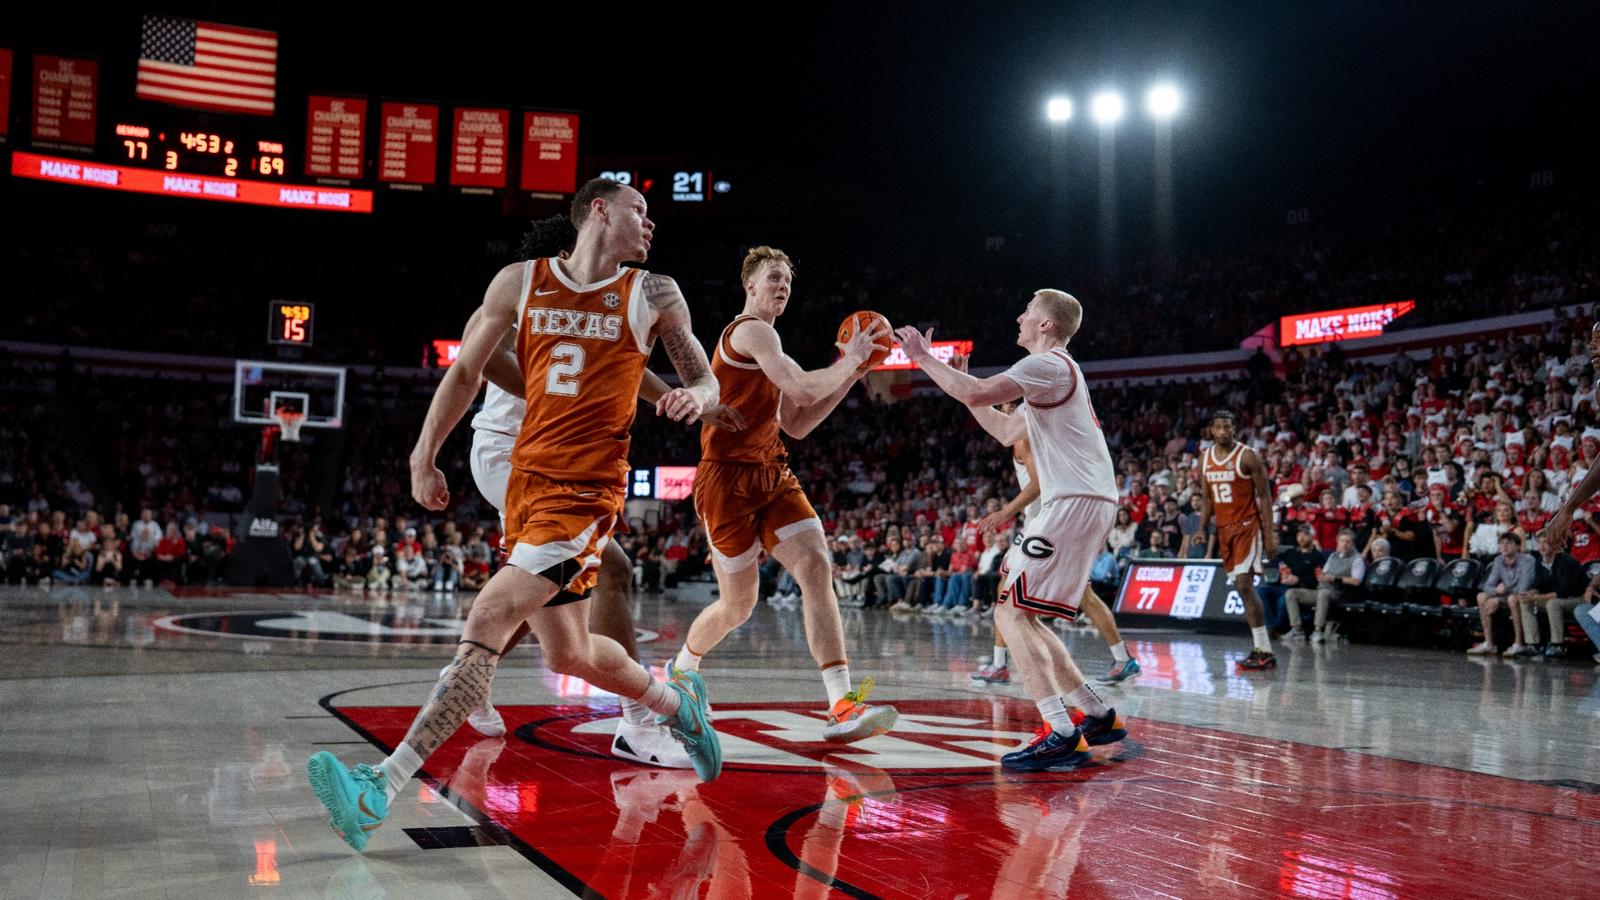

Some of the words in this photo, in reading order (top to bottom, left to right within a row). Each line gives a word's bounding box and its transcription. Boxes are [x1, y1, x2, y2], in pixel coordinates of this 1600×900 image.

[314, 110, 360, 124] CHAMPIONS
[387, 116, 432, 130] CHAMPIONS
[463, 111, 499, 122] NATIONAL
[533, 116, 569, 128] NATIONAL
[459, 121, 503, 134] CHAMPIONS
[529, 127, 574, 139] CHAMPIONS
[123, 140, 148, 160] 77
[180, 132, 220, 154] 4:53
[40, 160, 81, 180] MAKE
[165, 151, 178, 170] 3
[224, 158, 238, 176] 2
[259, 156, 284, 175] 69
[163, 176, 201, 193] MAKE
[203, 181, 237, 198] NOISE
[673, 171, 703, 193] 21
[279, 188, 315, 205] MAKE
[317, 192, 350, 207] NOISE
[284, 319, 305, 341] 15
[528, 307, 623, 341] TEXAS
[1295, 314, 1344, 340] MAKE
[545, 341, 585, 397] 2
[1206, 471, 1235, 483] TEXAS
[1212, 482, 1233, 504] 12
[1021, 536, 1056, 559] G
[1137, 587, 1160, 609] 77
